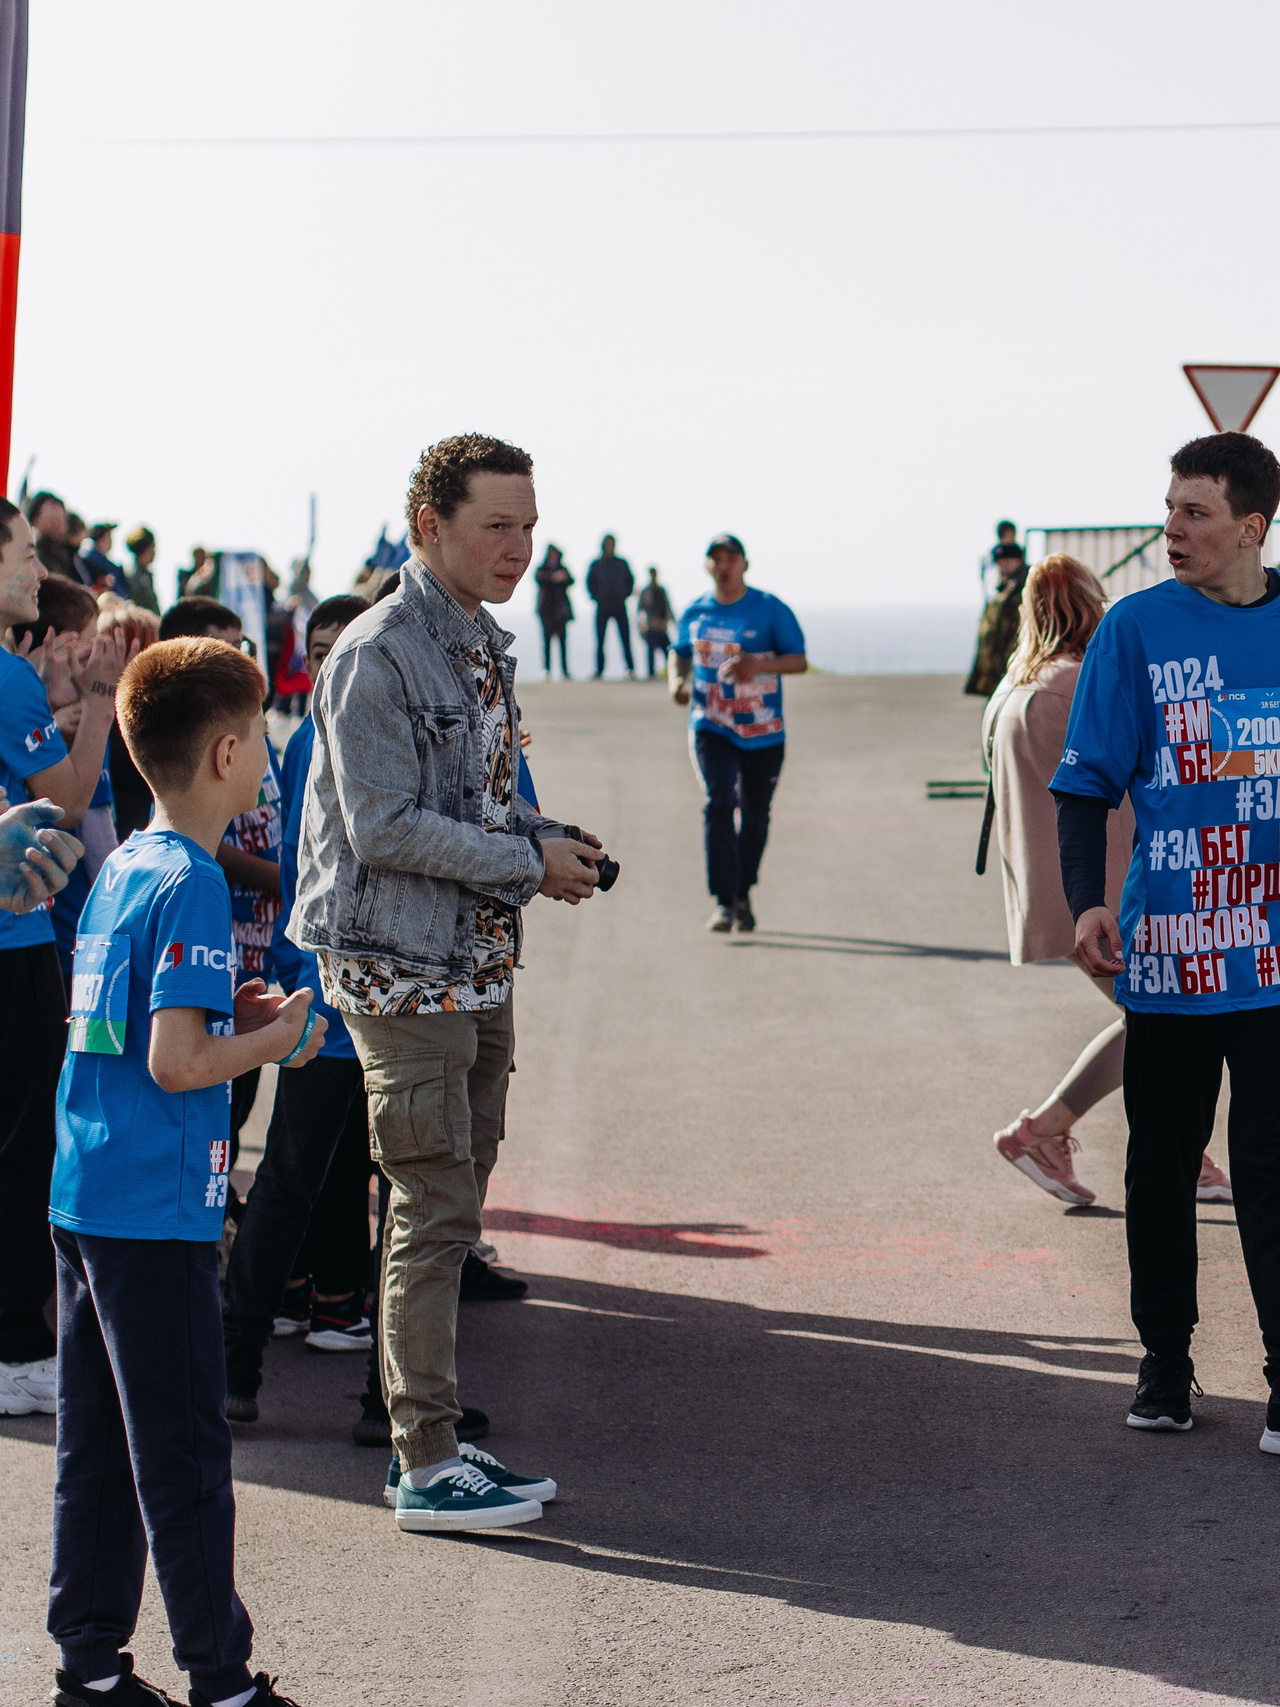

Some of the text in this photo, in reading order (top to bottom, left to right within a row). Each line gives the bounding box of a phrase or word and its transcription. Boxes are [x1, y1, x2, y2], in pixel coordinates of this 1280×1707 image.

[1148, 655, 1224, 704] 2024
[1228, 693, 1246, 701] ПСБ
[1149, 823, 1250, 870] #ЗАБЕГ
[1133, 905, 1271, 955] #ЛЮБОВЬ
[1128, 952, 1228, 995] #ЗАБЕГ
